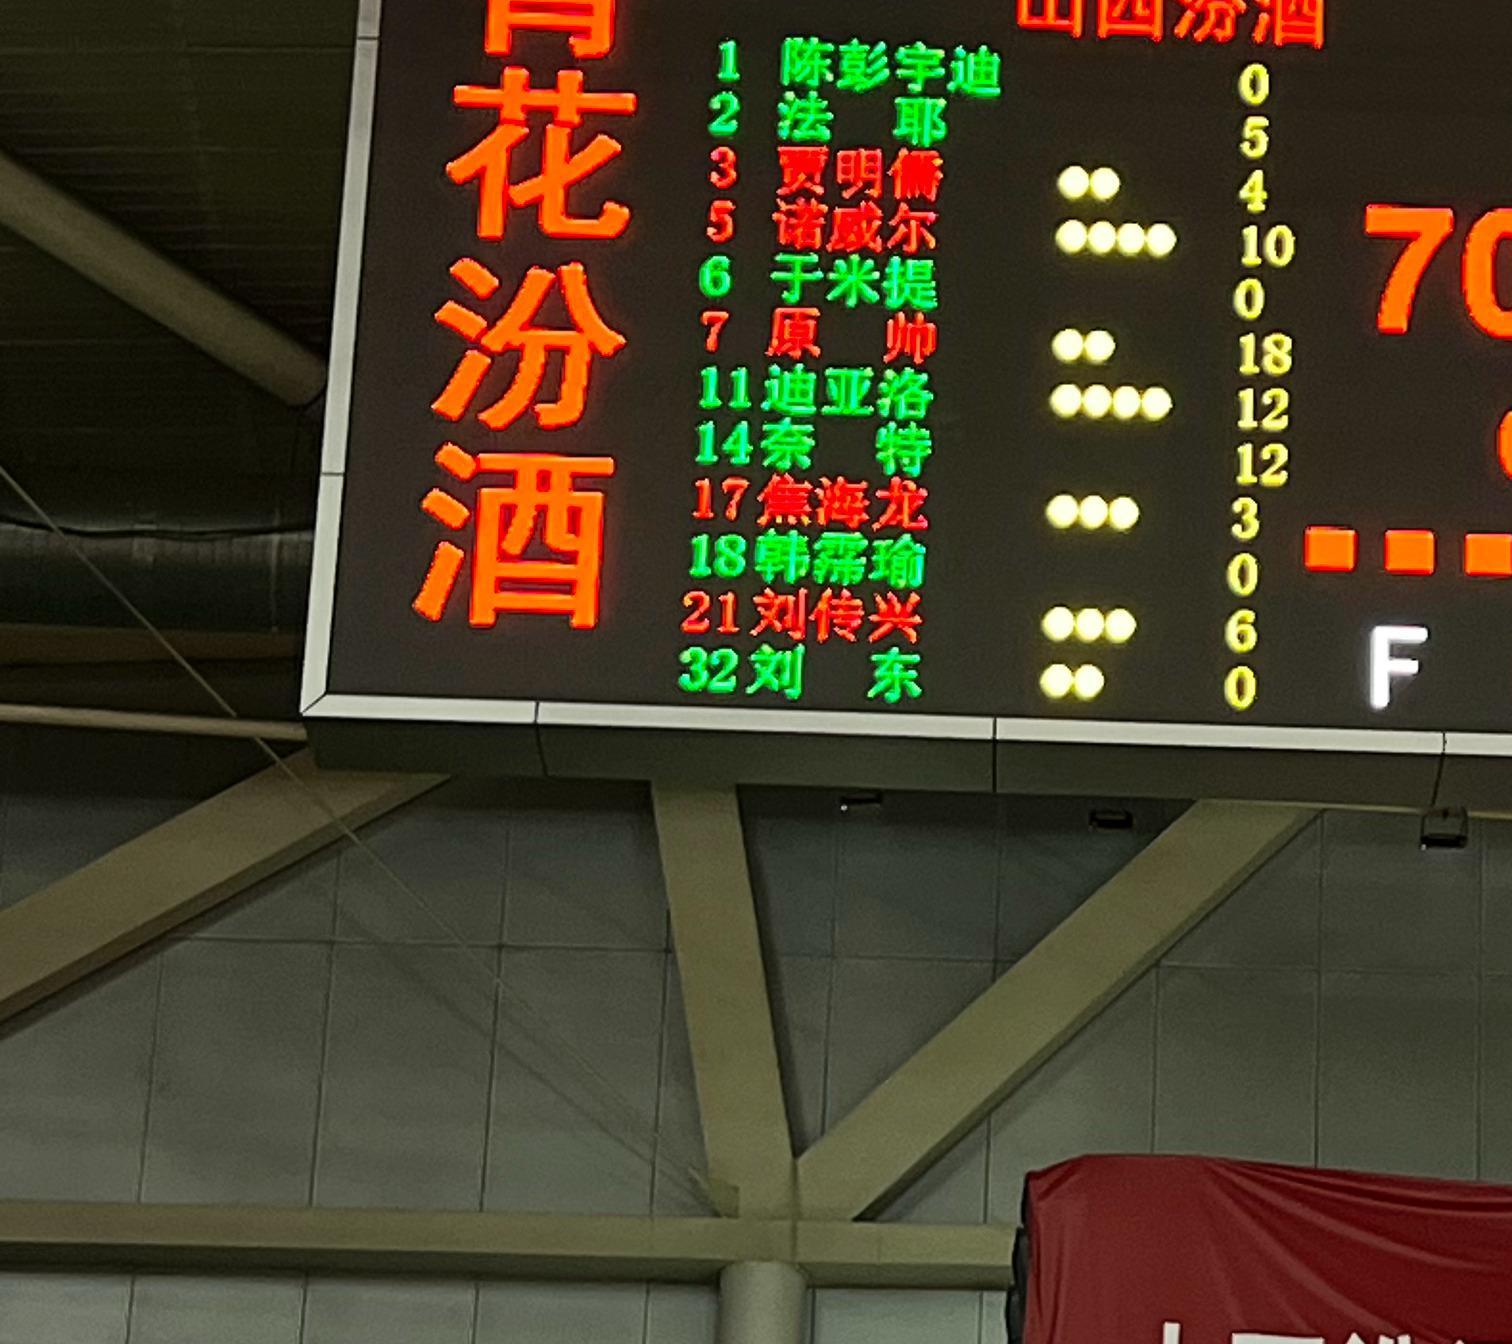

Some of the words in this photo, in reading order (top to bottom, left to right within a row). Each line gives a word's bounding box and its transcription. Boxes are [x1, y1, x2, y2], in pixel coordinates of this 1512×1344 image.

[717, 39, 740, 81] 1
[778, 37, 1001, 97] 陈彭宇迪
[1239, 64, 1269, 105] 0
[708, 90, 740, 136] 2
[1240, 116, 1269, 158] 5
[709, 146, 737, 189] 3
[1239, 170, 1267, 213] 4
[707, 200, 737, 243] 5
[772, 198, 937, 254] 诺威尔
[1242, 225, 1295, 266] 10
[698, 255, 732, 297] 6
[770, 252, 939, 311] 于米提
[1234, 278, 1264, 320] 0
[701, 311, 729, 352] 7
[1240, 333, 1292, 376] 18
[698, 366, 752, 409] 11
[761, 363, 934, 420] 迪亚洛
[1238, 388, 1288, 431] 12
[694, 420, 753, 465] 14
[1237, 443, 1288, 486] 12
[692, 477, 750, 520] 17
[756, 472, 929, 531] 焦海龙
[1232, 497, 1259, 541] 3
[689, 533, 746, 578] 18
[1227, 553, 1258, 596] 0
[681, 590, 740, 634] 21
[749, 587, 923, 644] 刘传兴
[1225, 609, 1257, 653] 6
[678, 646, 739, 693] 32
[1224, 666, 1256, 710] 0
[1370, 625, 1428, 709] F
